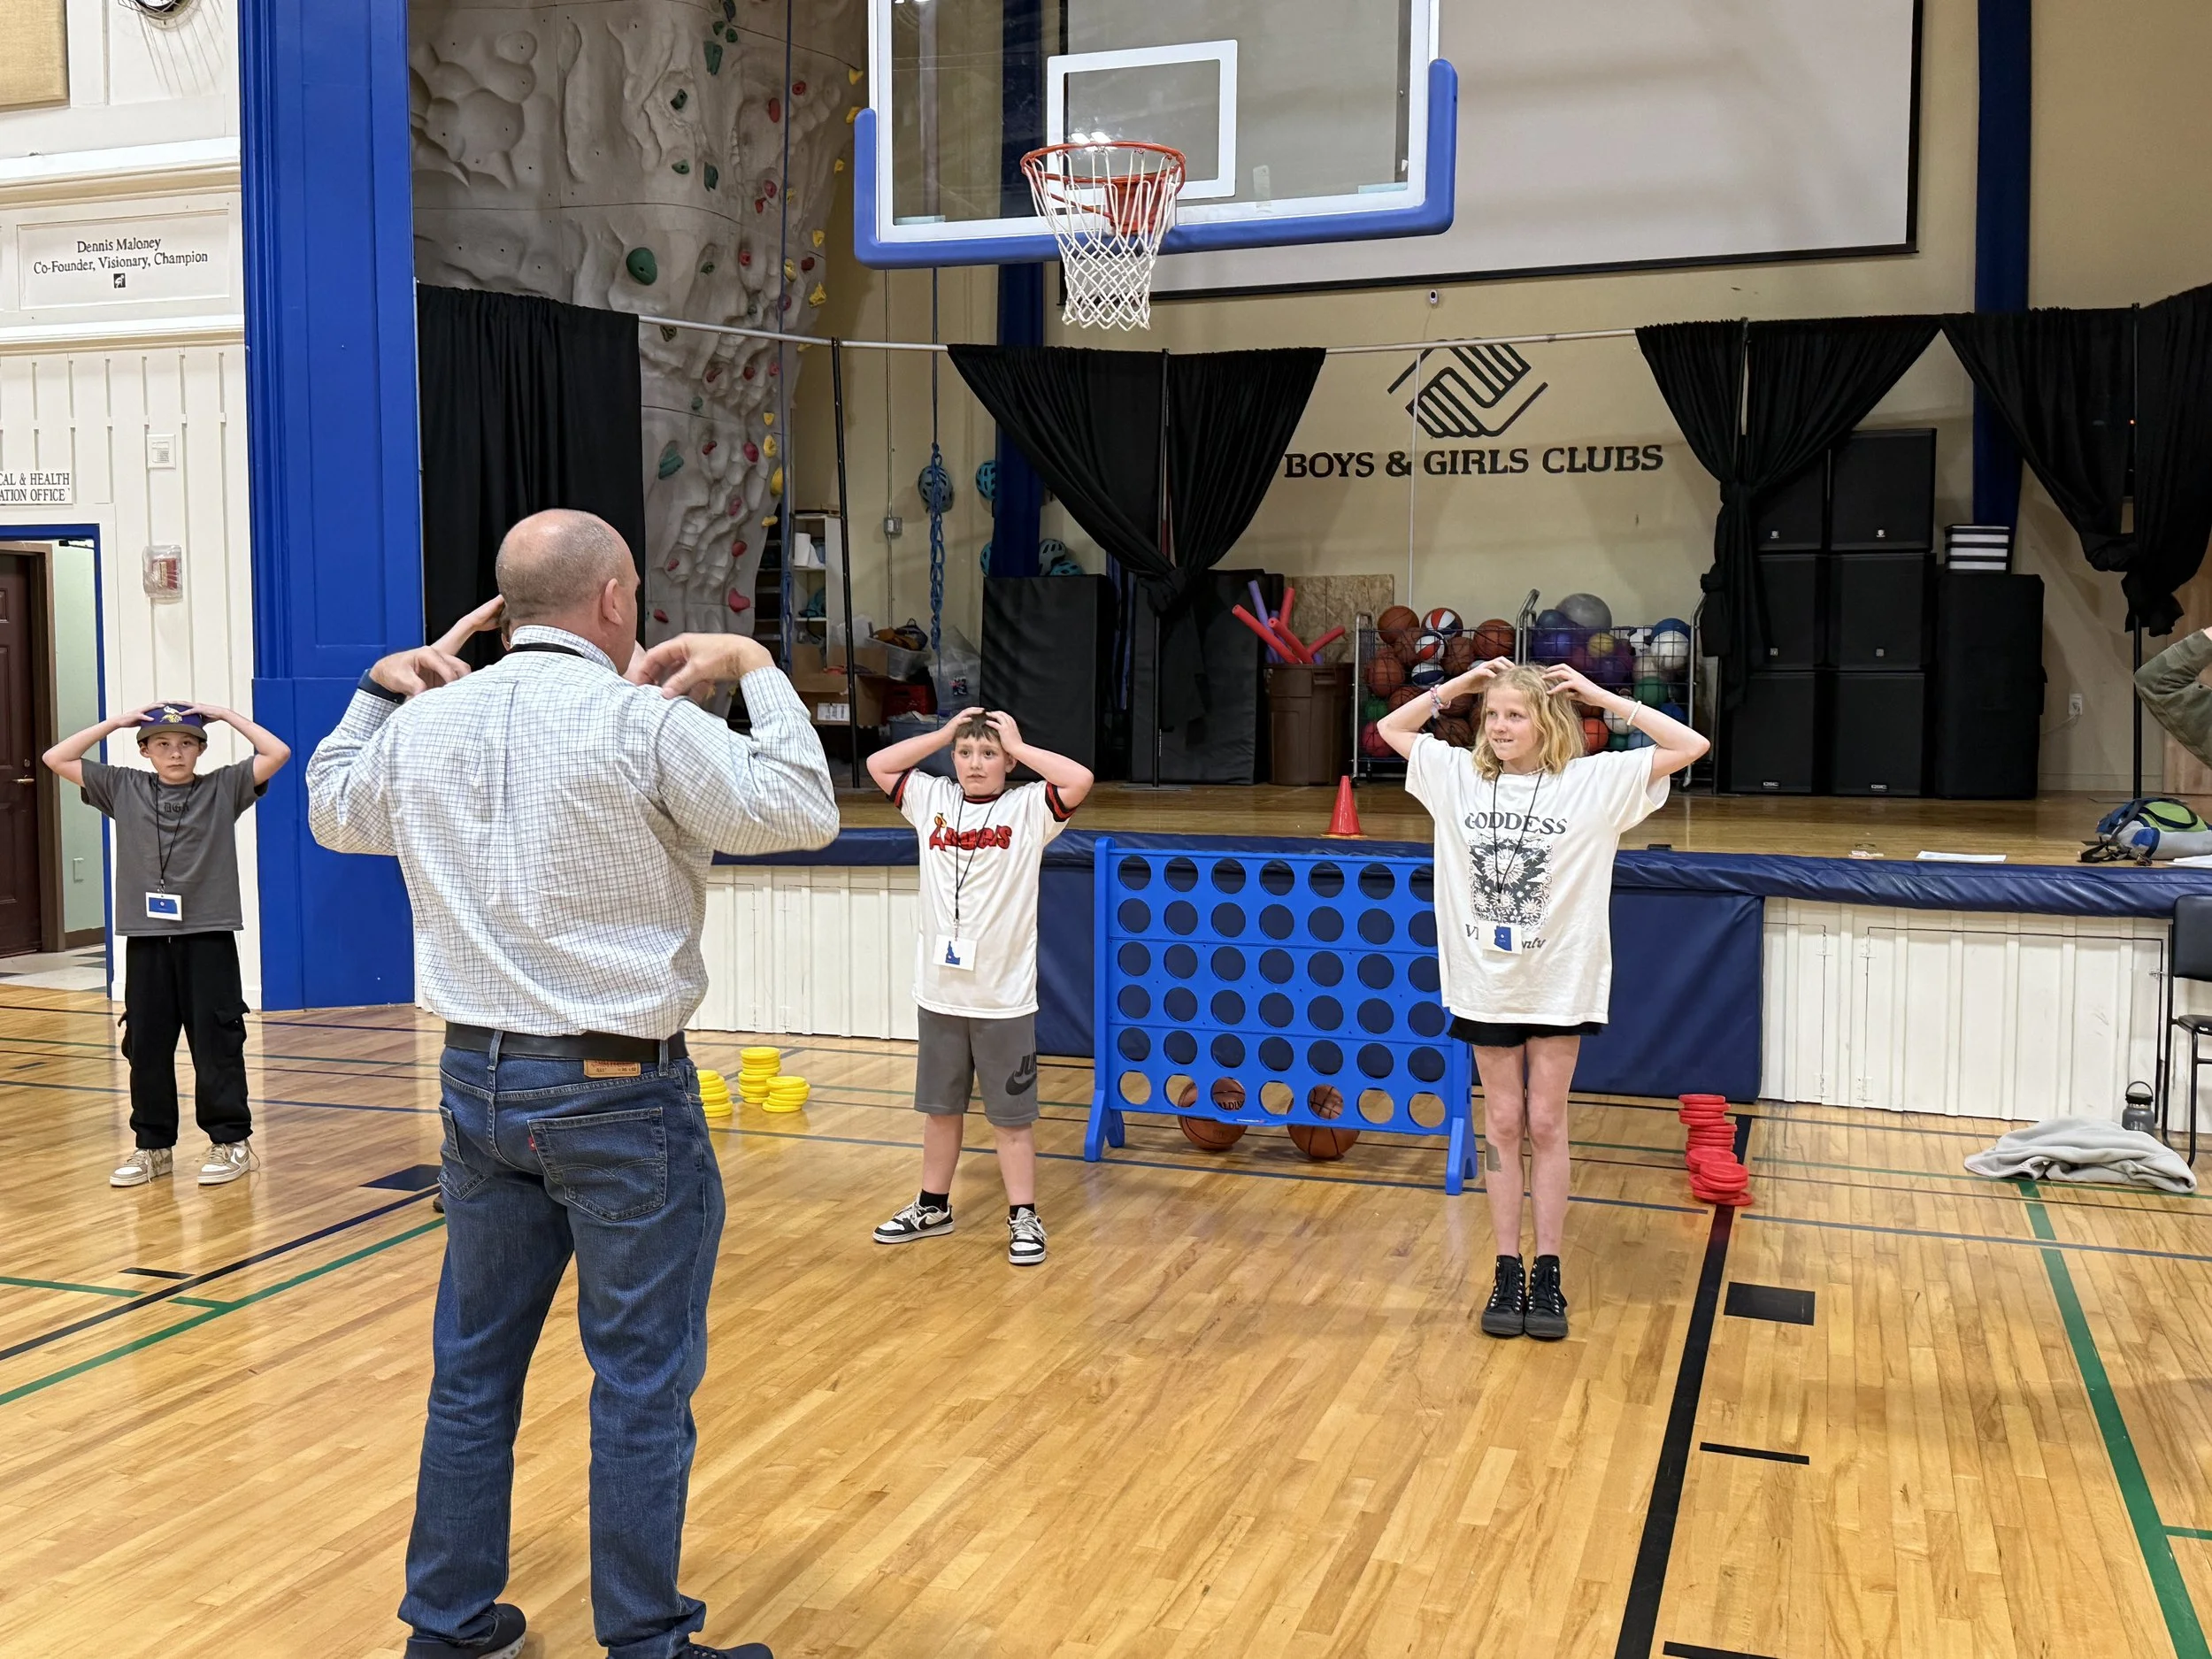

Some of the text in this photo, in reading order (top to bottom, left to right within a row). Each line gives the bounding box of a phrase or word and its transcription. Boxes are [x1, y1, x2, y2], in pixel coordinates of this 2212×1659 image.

[77, 237, 161, 253] Dennis Maloney
[34, 250, 208, 274] Co-Founder, Visionary, Champion
[1284, 444, 1663, 478] BOYS & GIRLS CLUBS
[0, 472, 70, 486] CAL & HEALTH
[0, 488, 65, 502] ATION OFFICE
[1464, 811, 1567, 834] GODDESS
